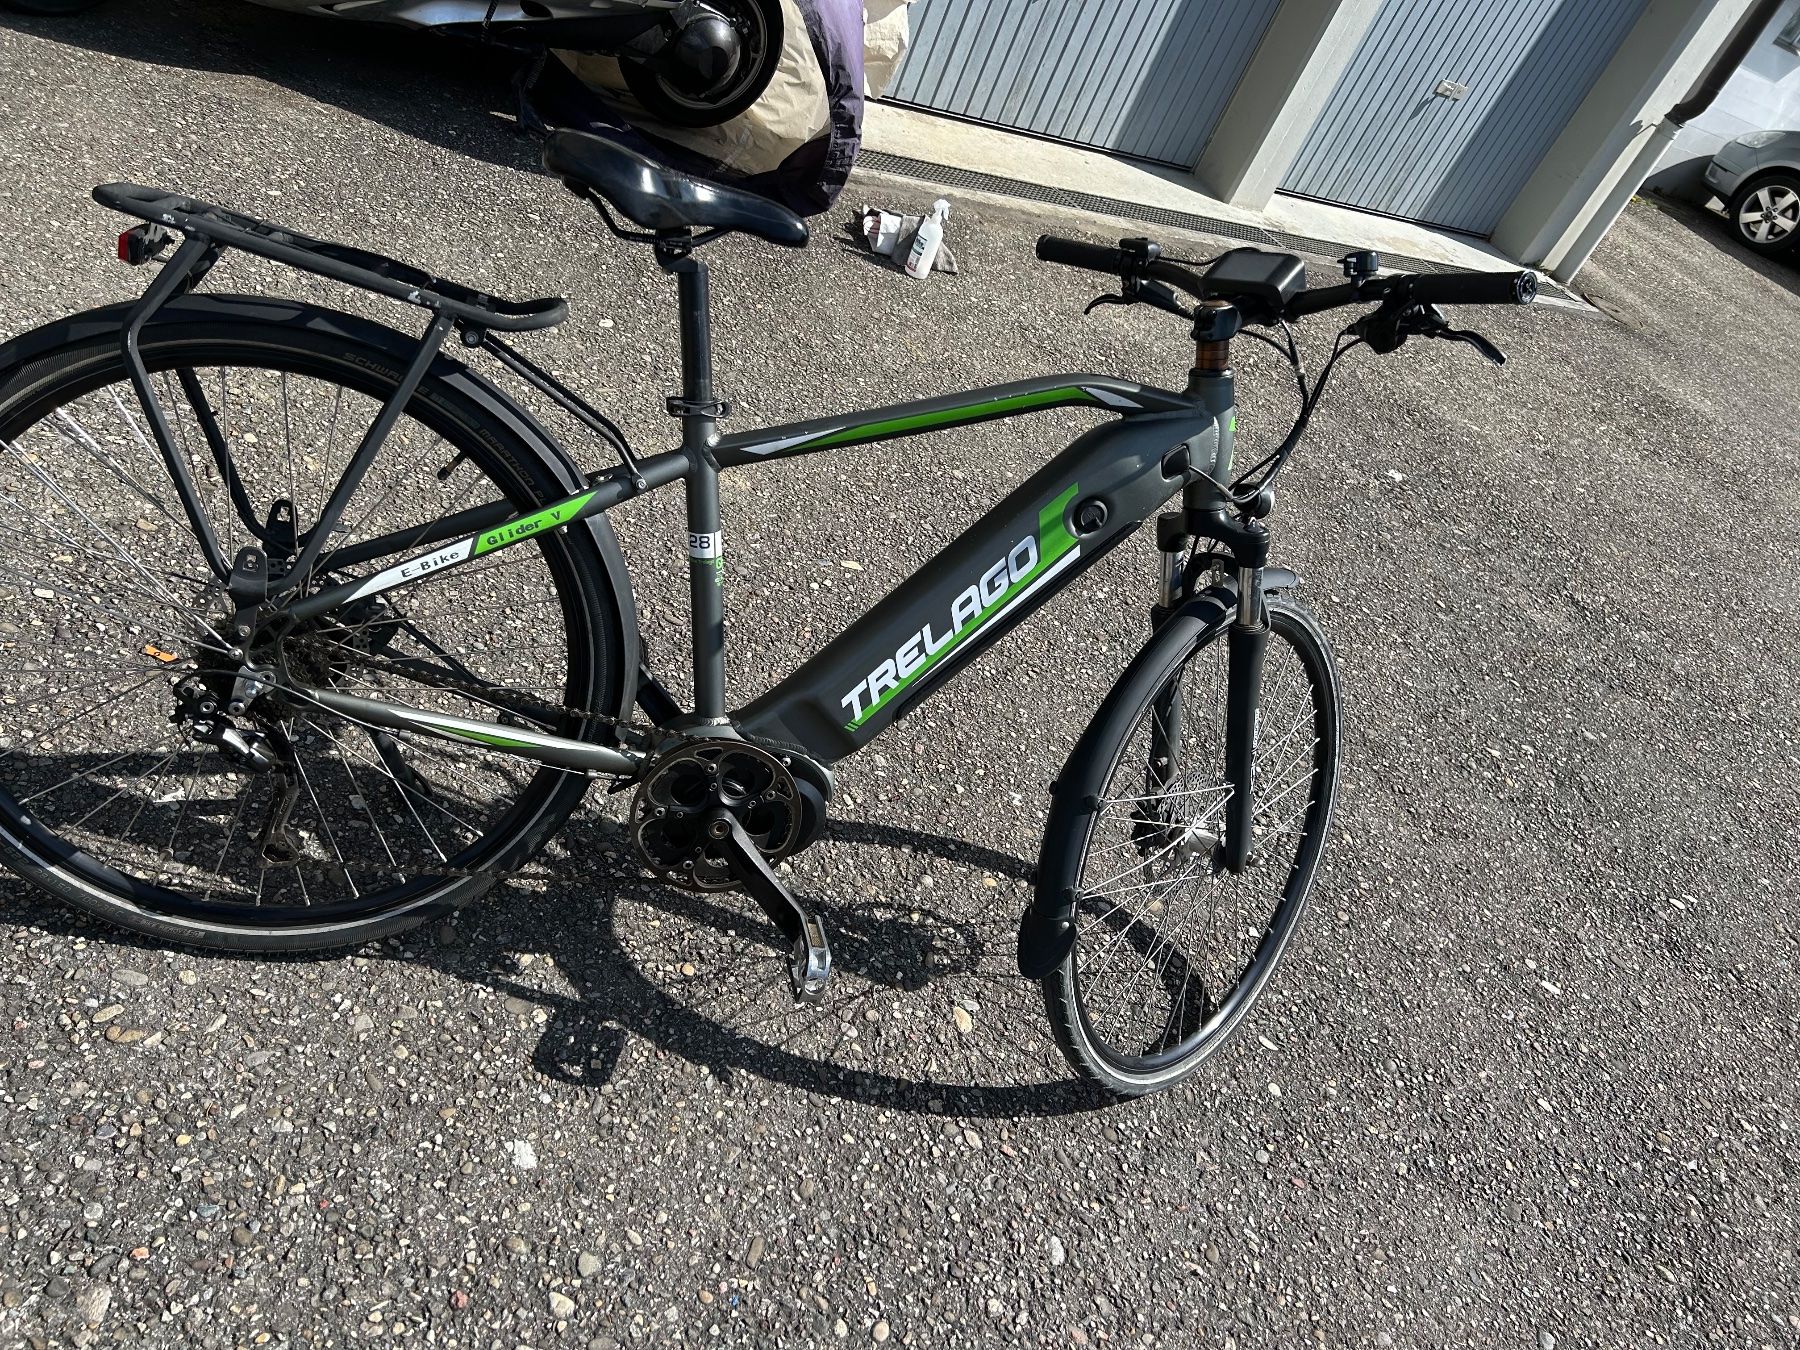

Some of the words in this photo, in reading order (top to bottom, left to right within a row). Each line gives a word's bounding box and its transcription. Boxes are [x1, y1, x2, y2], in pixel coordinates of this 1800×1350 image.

[401, 551, 460, 578] E-Bike
[486, 519, 543, 546] Glider
[550, 510, 562, 521] V
[689, 534, 711, 550] 28
[841, 535, 1039, 722] TRELAGO
